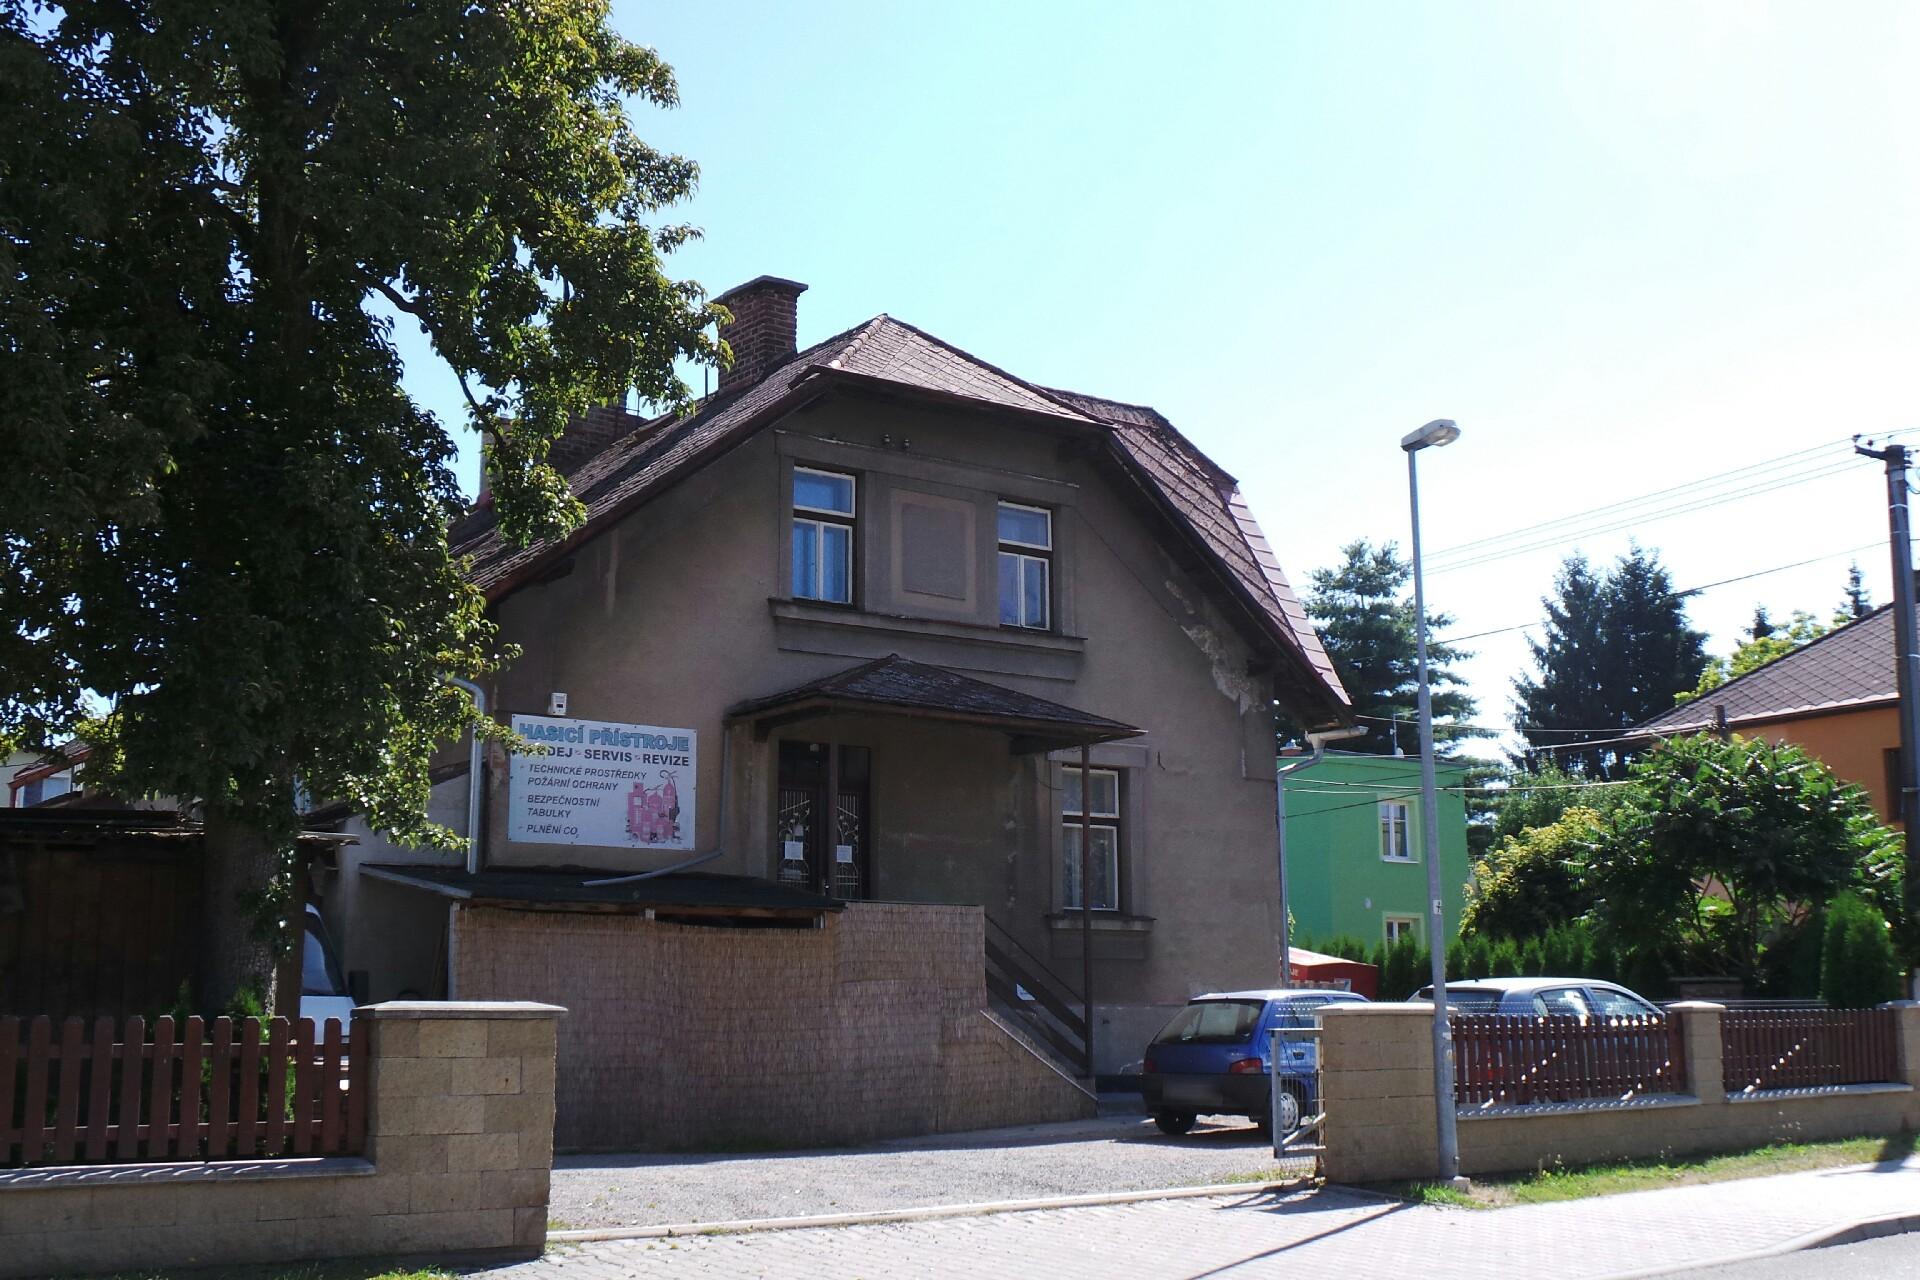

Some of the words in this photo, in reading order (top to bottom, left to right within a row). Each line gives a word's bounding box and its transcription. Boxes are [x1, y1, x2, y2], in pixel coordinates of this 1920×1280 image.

[518, 723, 585, 744] HASICÍ
[588, 727, 690, 752] PŘÍSTROJE
[584, 748, 633, 762] SERVIS
[642, 753, 690, 767] REVIZE
[528, 763, 582, 776] TECHNICKÉ
[584, 767, 648, 780] PROSTŘEDKY
[527, 776, 571, 788] POŽÁRNÍ
[572, 780, 619, 791] OCHRANY
[527, 794, 600, 807] BEZPEČNOSTNÍ
[527, 807, 571, 819] TABULKY
[526, 823, 562, 834] PLNĚNÍ
